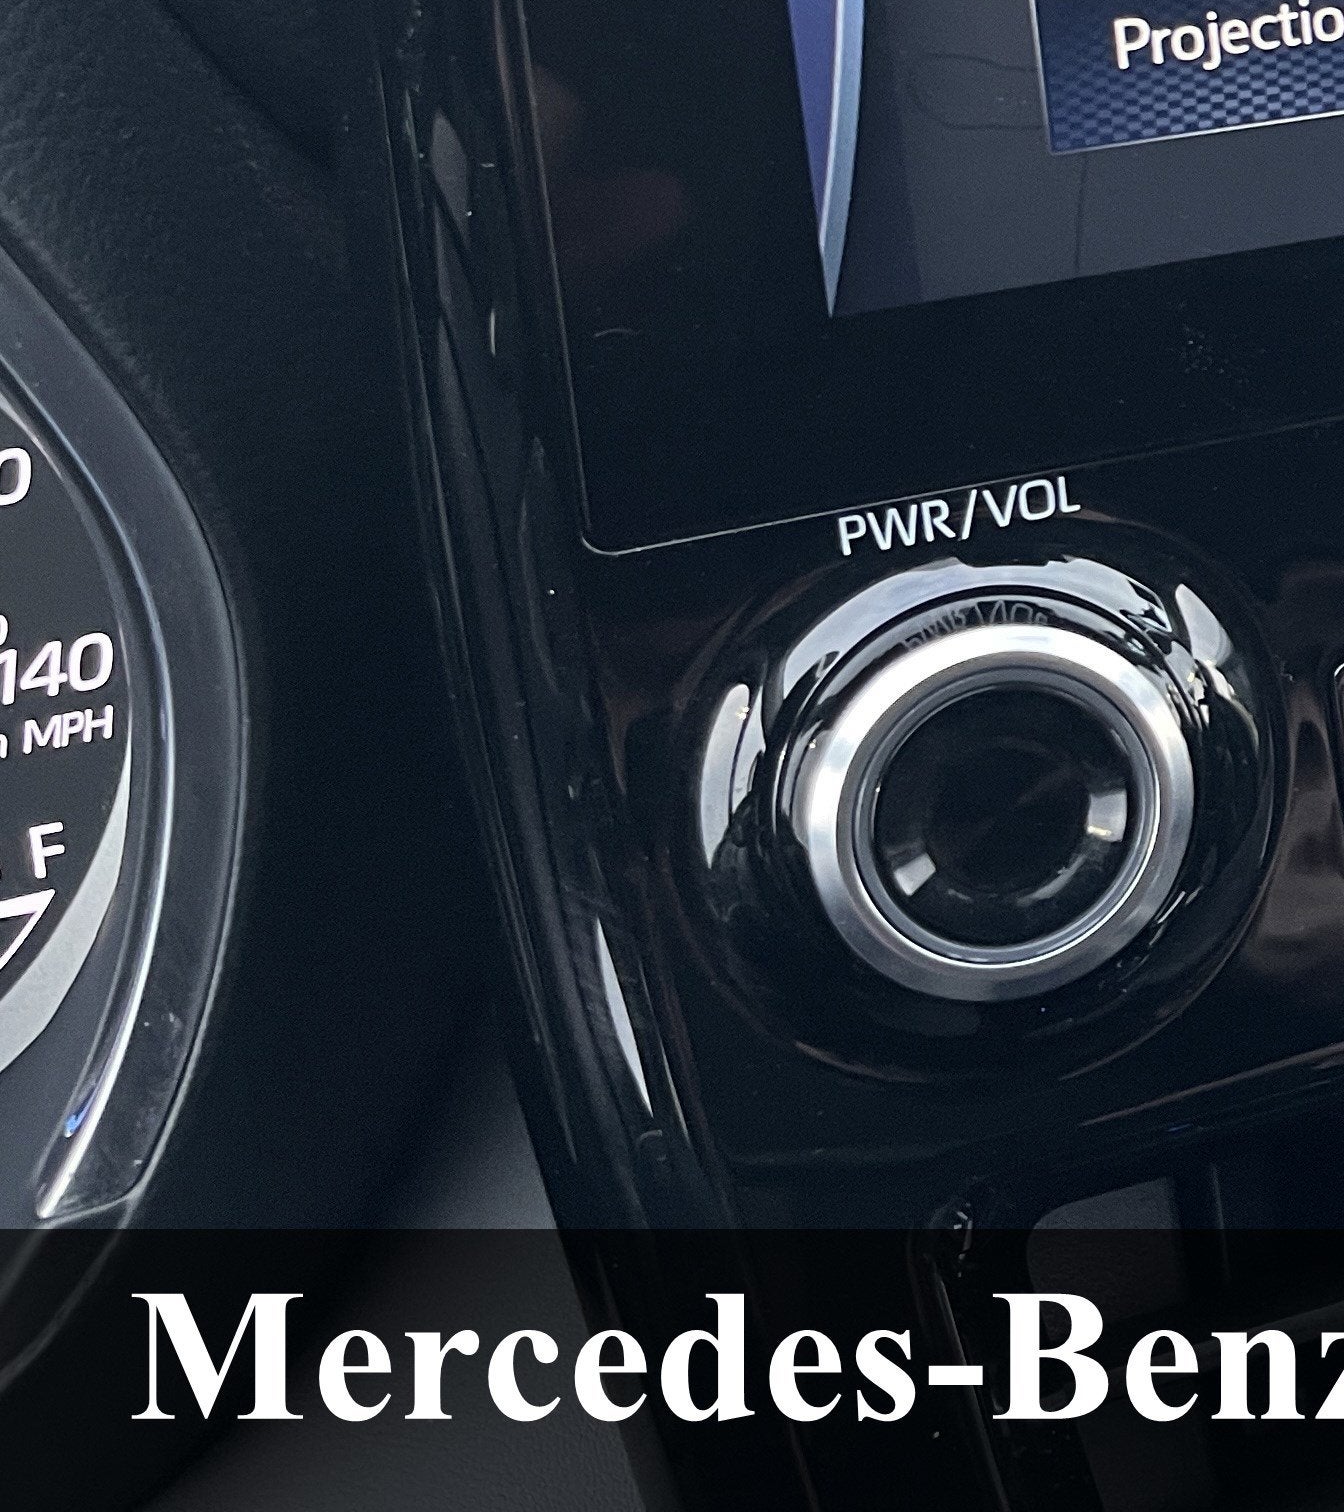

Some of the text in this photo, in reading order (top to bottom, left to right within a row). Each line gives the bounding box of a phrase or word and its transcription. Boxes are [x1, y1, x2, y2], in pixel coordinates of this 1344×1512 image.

[837, 476, 1081, 556] PWR/VOL
[21, 703, 115, 755] MPH
[28, 820, 66, 880] F
